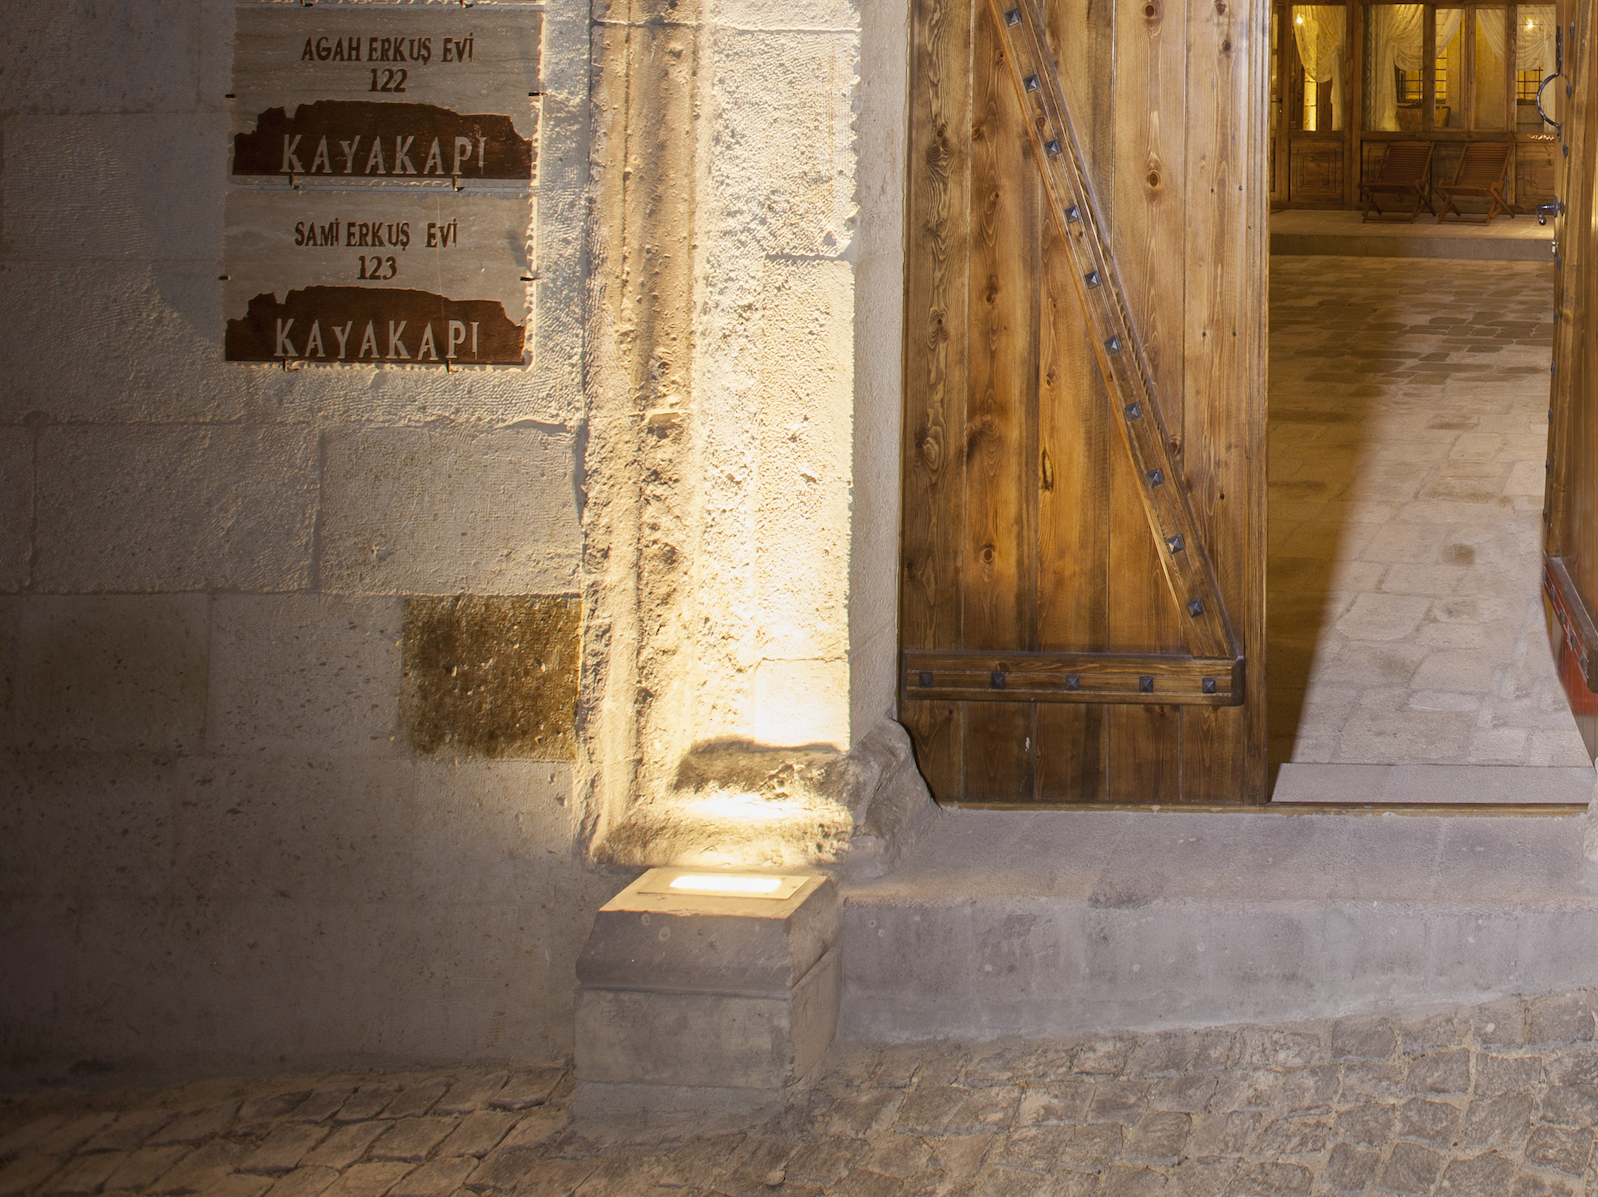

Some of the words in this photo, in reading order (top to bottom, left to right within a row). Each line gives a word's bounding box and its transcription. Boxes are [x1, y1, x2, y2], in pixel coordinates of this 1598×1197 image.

[301, 36, 361, 62] AGAH
[368, 37, 432, 66] ERKUŞ
[441, 32, 474, 63] EVİ
[369, 69, 408, 93] 122
[281, 134, 486, 175] KAYAKAPI
[294, 218, 340, 247] SAMİ
[345, 221, 410, 251] ERKUŞ
[426, 217, 457, 248] EVİ
[357, 256, 397, 280] 123
[274, 318, 479, 360] KAYAKAPI
